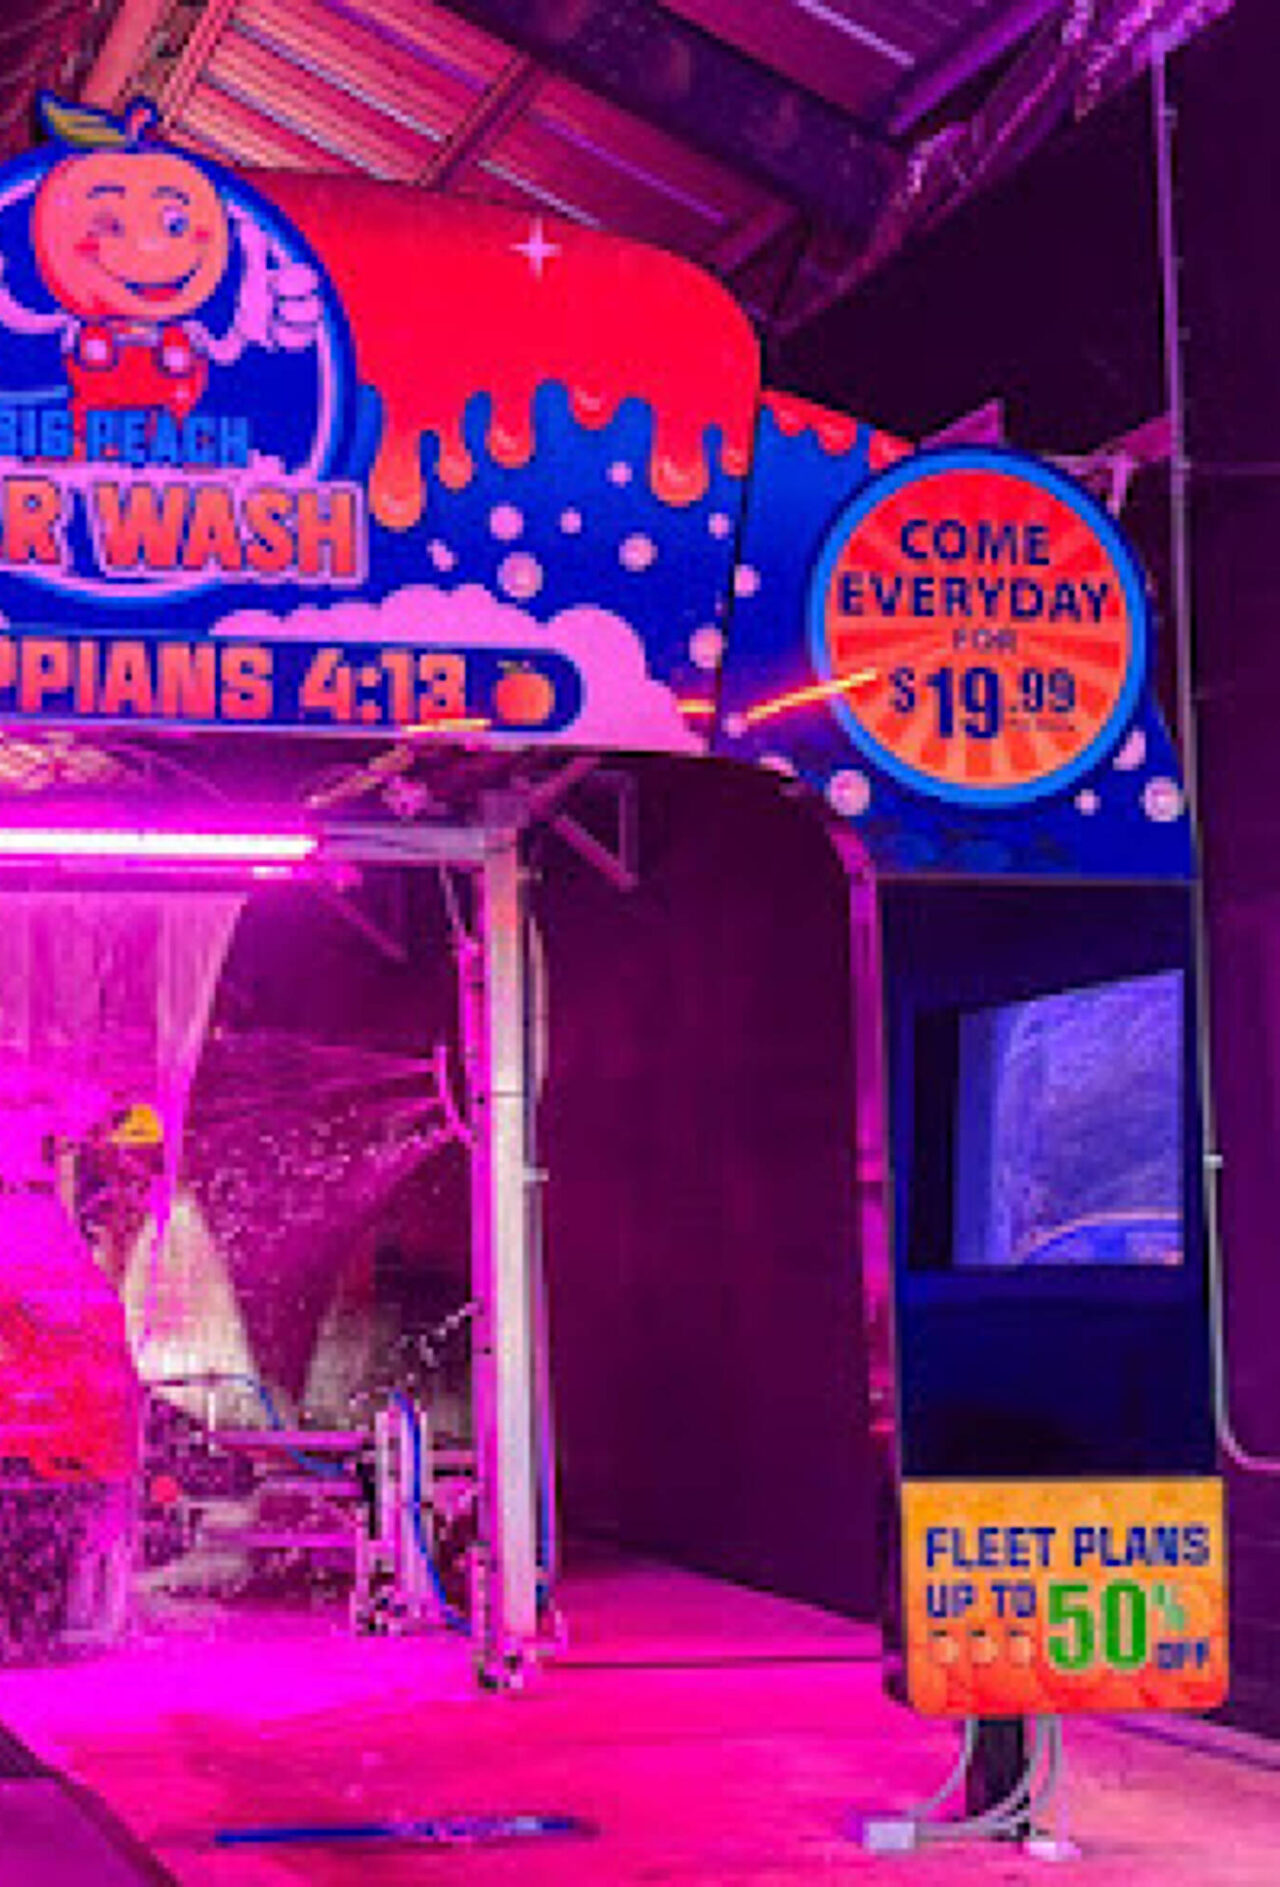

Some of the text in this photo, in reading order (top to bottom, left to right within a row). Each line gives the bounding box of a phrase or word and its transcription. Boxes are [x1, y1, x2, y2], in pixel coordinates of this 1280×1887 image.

[86, 409, 249, 468] PEACH
[93, 480, 358, 578] WASH
[900, 519, 1050, 566] COME
[838, 573, 1108, 623] EVERYDAY
[300, 648, 466, 722] 4:13
[926, 1524, 1211, 1568] FLEET PLANS
[926, 1582, 976, 1619] UP
[990, 1582, 1037, 1619] TO
